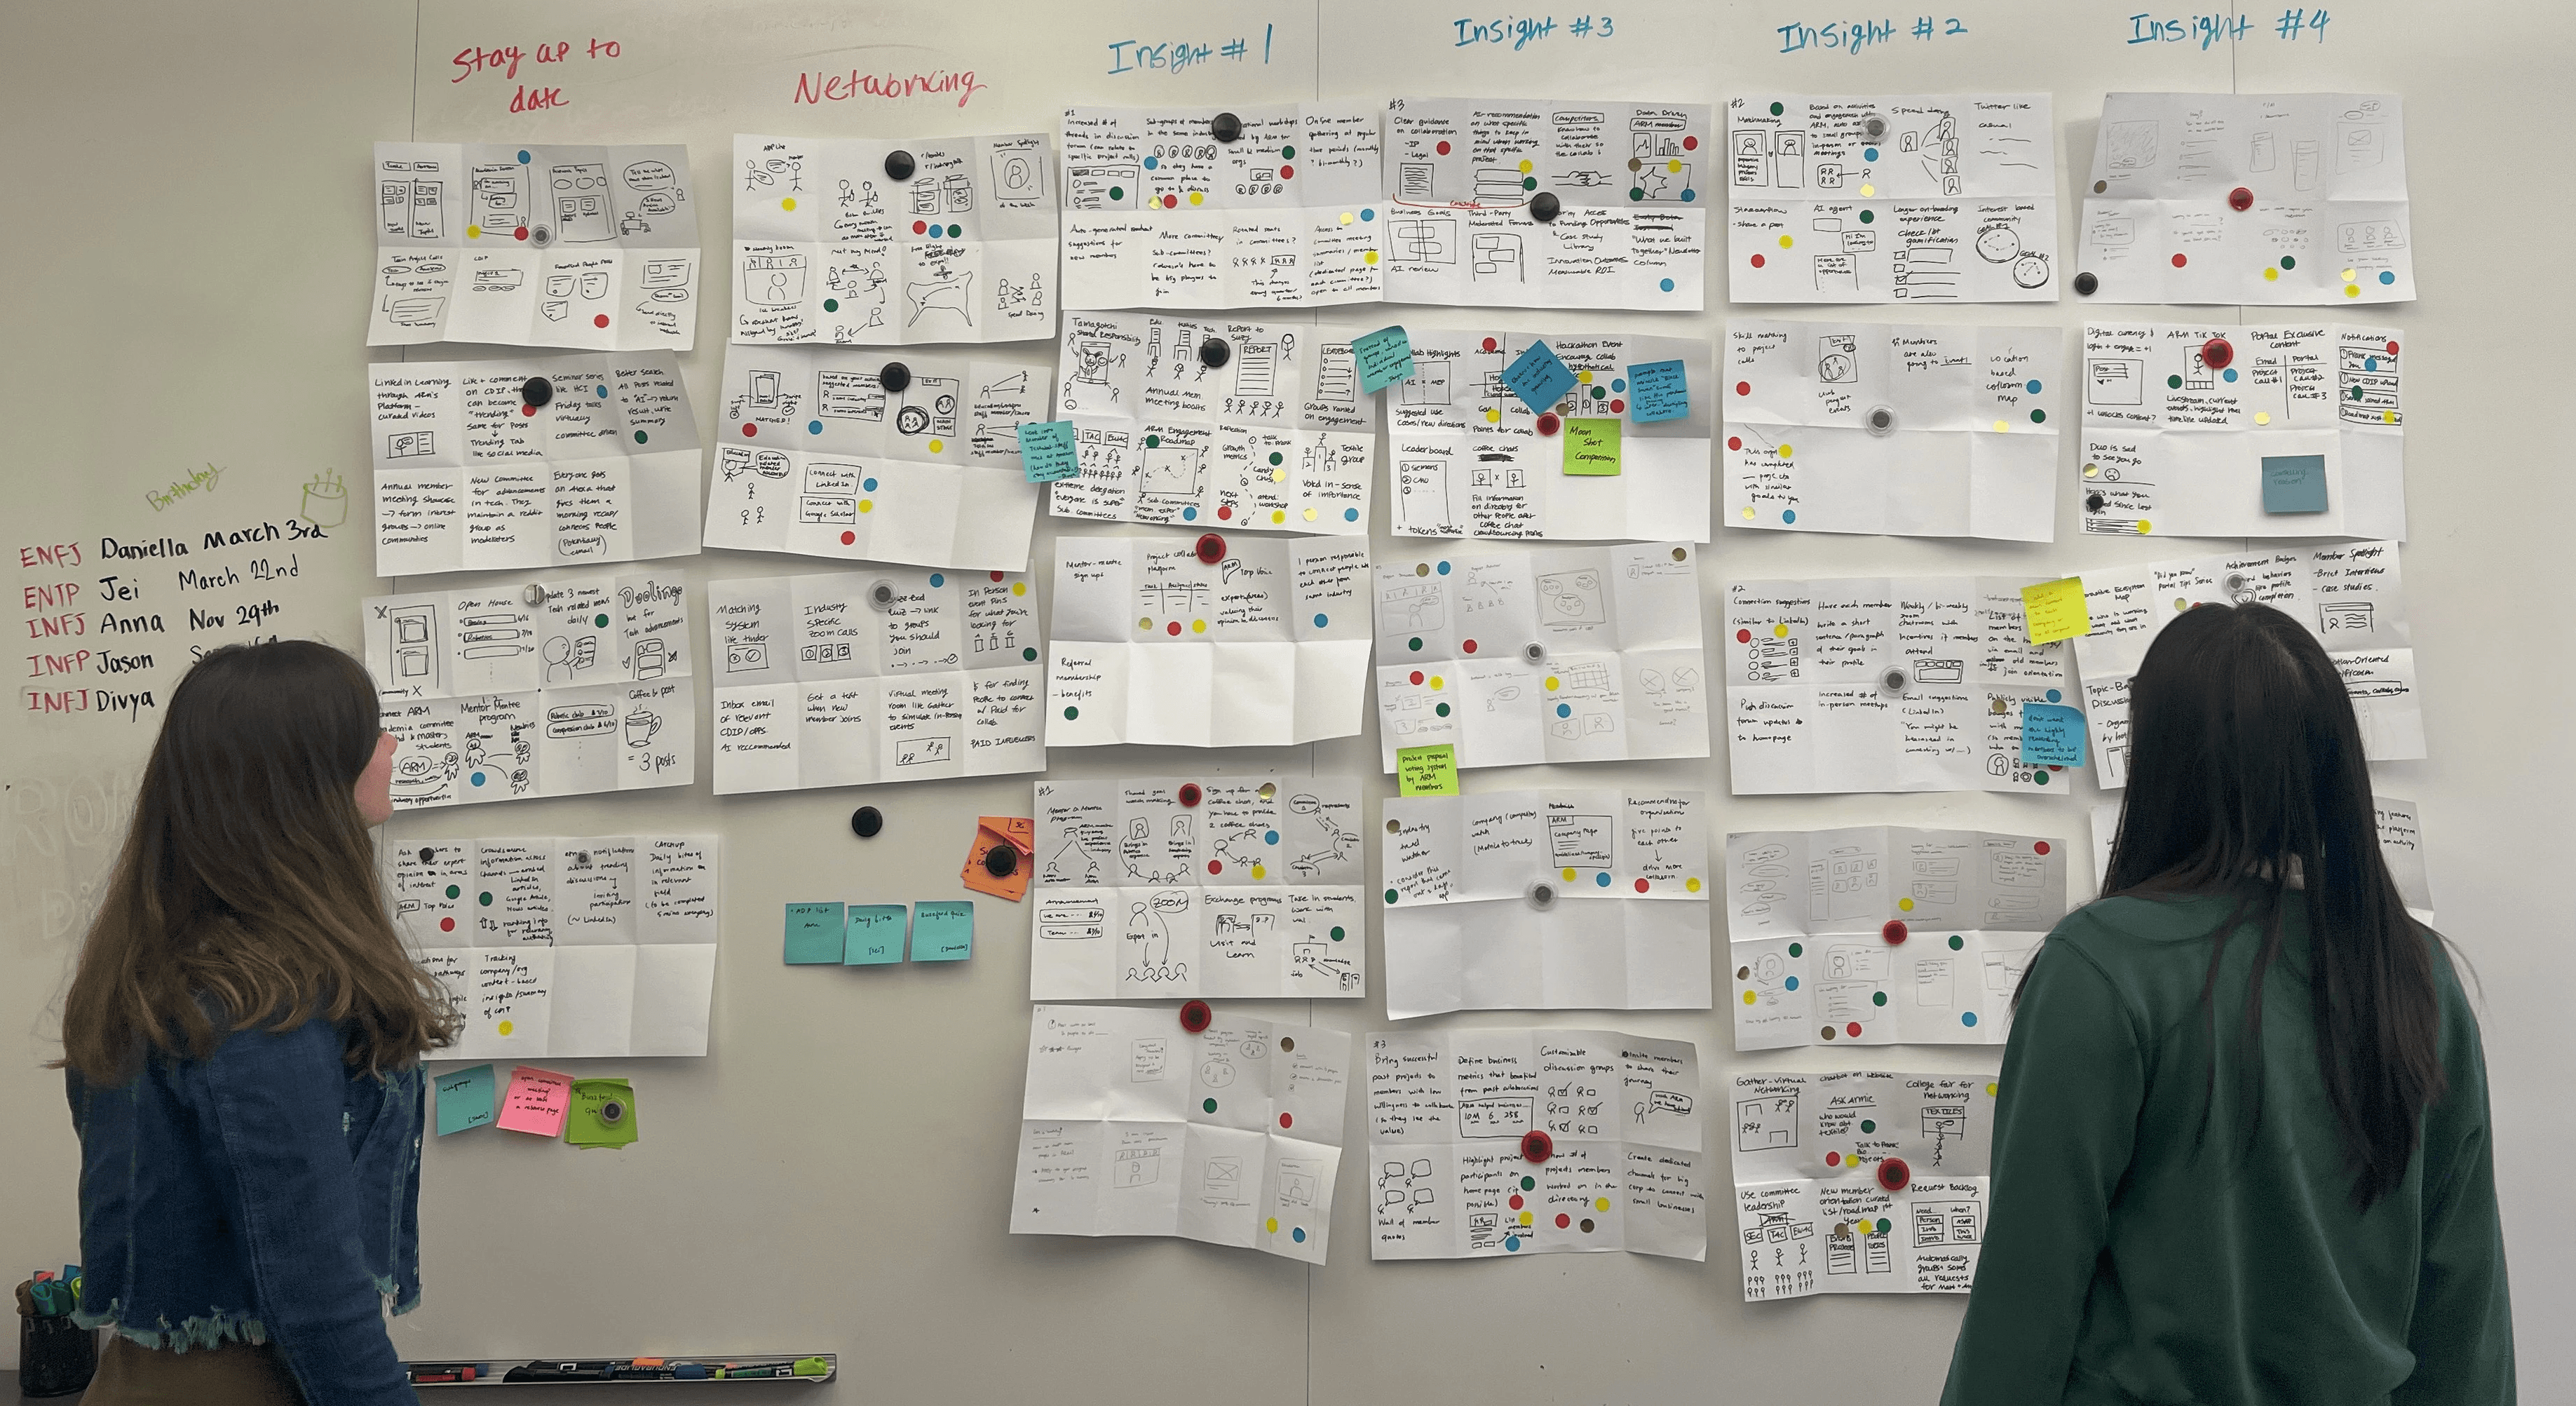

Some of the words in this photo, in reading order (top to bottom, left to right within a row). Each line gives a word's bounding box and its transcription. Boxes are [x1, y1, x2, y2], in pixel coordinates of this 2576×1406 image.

[1454, 17, 1557, 50] Insight
[1777, 19, 1895, 55] Insight
[2127, 13, 2253, 50] Insight
[452, 46, 527, 83] Stay
[586, 38, 621, 59] to
[1108, 40, 1214, 74] Insight
[509, 85, 570, 114] date
[794, 71, 987, 107] Networking
[20, 542, 83, 569] ENFJ
[101, 538, 189, 562] Daniella
[203, 522, 280, 552] March
[286, 520, 328, 541] 3rd
[100, 576, 140, 602] Jei
[179, 565, 240, 592] March
[251, 554, 299, 581] 22nd
[25, 611, 86, 639] INFJ
[101, 612, 166, 635] Anna
[189, 609, 225, 633] Nov
[236, 601, 280, 626] 29th
[27, 650, 90, 678] INFP
[97, 651, 155, 677] Jason
[27, 689, 90, 714] INFJ
[96, 689, 156, 724] Divya
